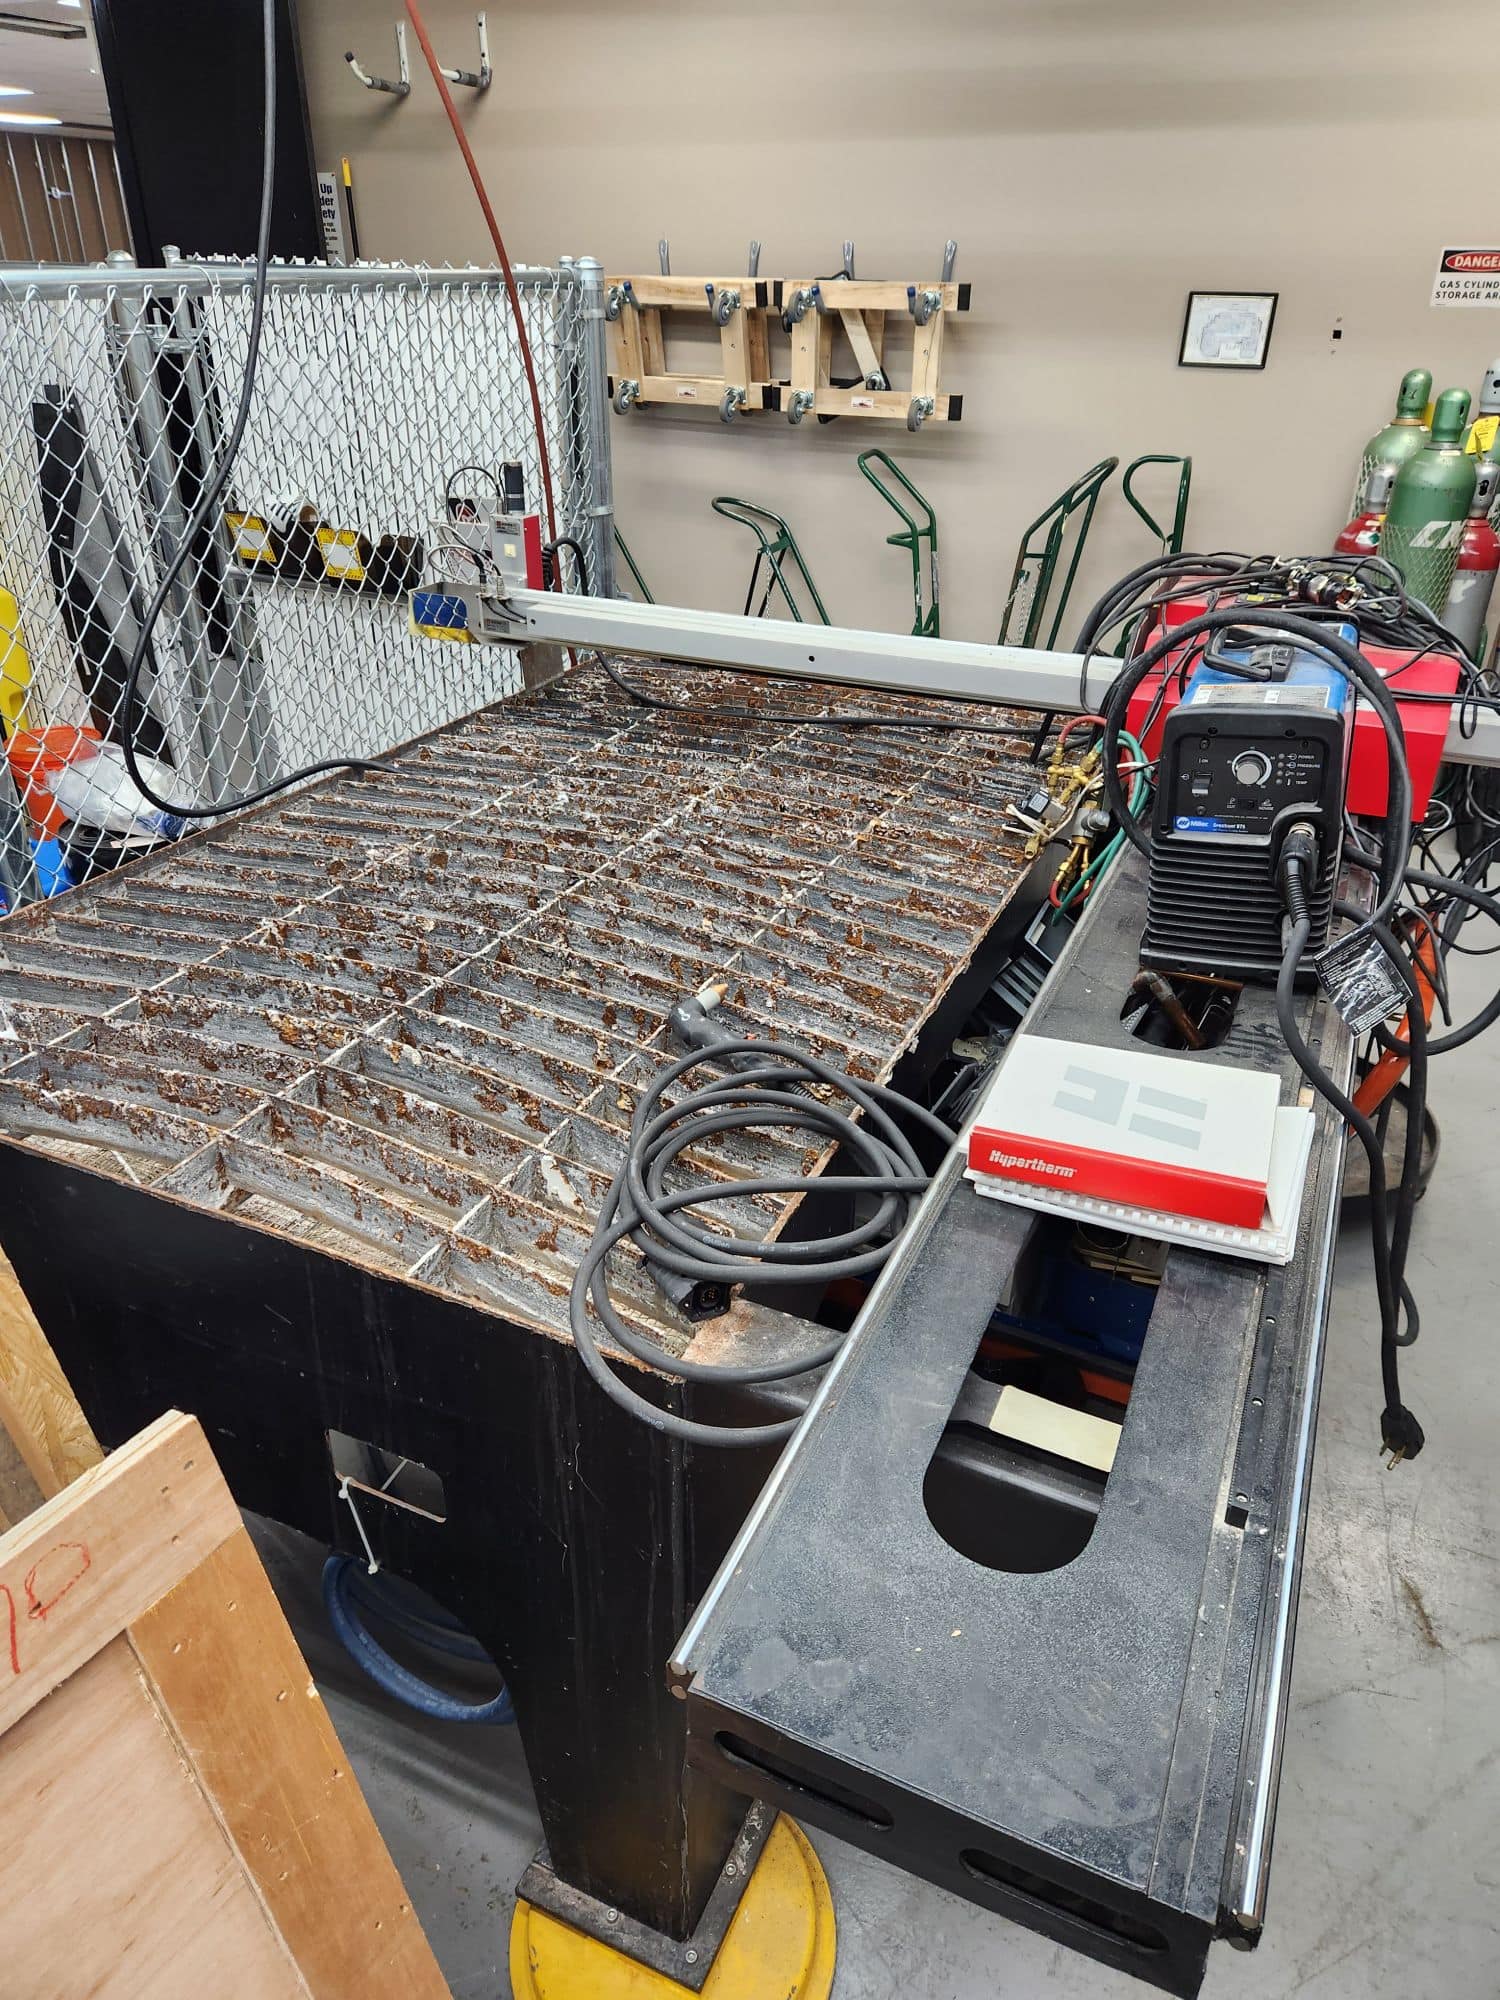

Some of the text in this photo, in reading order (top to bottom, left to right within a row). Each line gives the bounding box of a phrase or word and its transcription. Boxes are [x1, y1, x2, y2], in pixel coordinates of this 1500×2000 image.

[320, 184, 332, 194] Up
[1454, 256, 1500, 268] DANGE
[1439, 280, 1500, 289] GAS CYLIND
[1435, 290, 1482, 299] STORAGE
[1190, 820, 1209, 828] Miller
[988, 1149, 1075, 1178] Hypertherm
